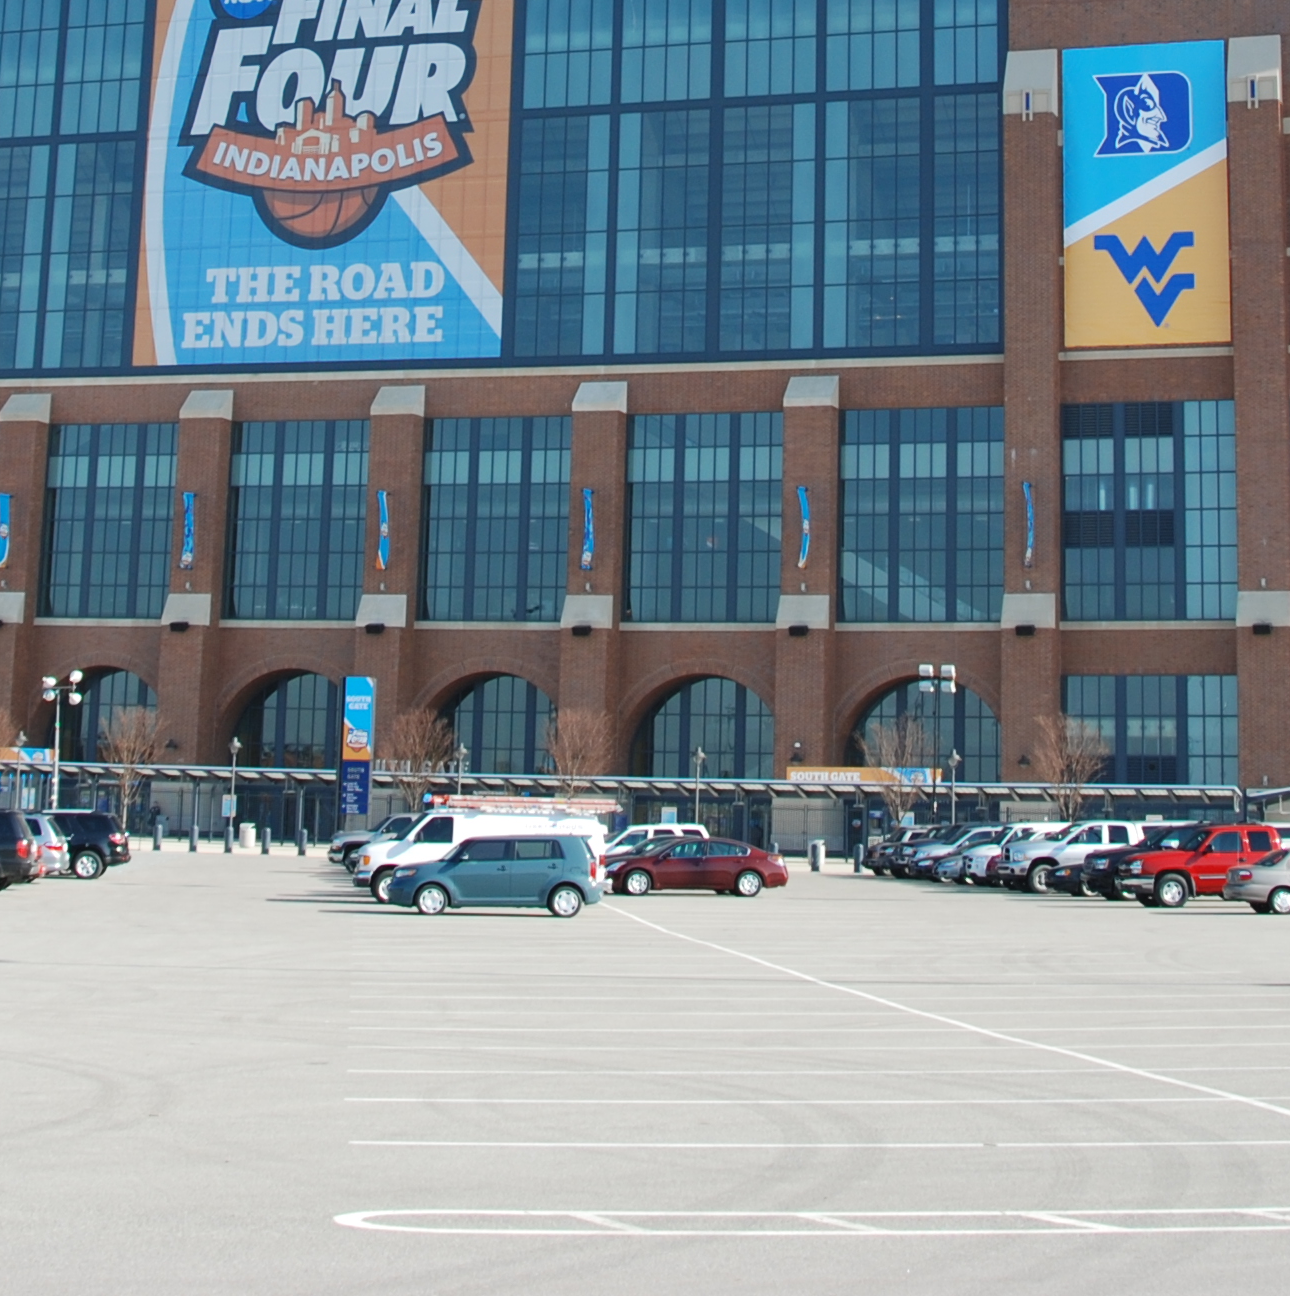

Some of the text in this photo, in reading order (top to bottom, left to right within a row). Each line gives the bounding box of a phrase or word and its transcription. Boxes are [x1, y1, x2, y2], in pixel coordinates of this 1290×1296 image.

[190, 25, 467, 136] FOUR
[212, 131, 444, 182] INDIANAPOLIS
[206, 261, 445, 304] THE ROAD
[181, 306, 444, 349] ENDS HERE
[348, 702, 369, 710] GATE
[790, 771, 861, 782] SOUTH GATE
